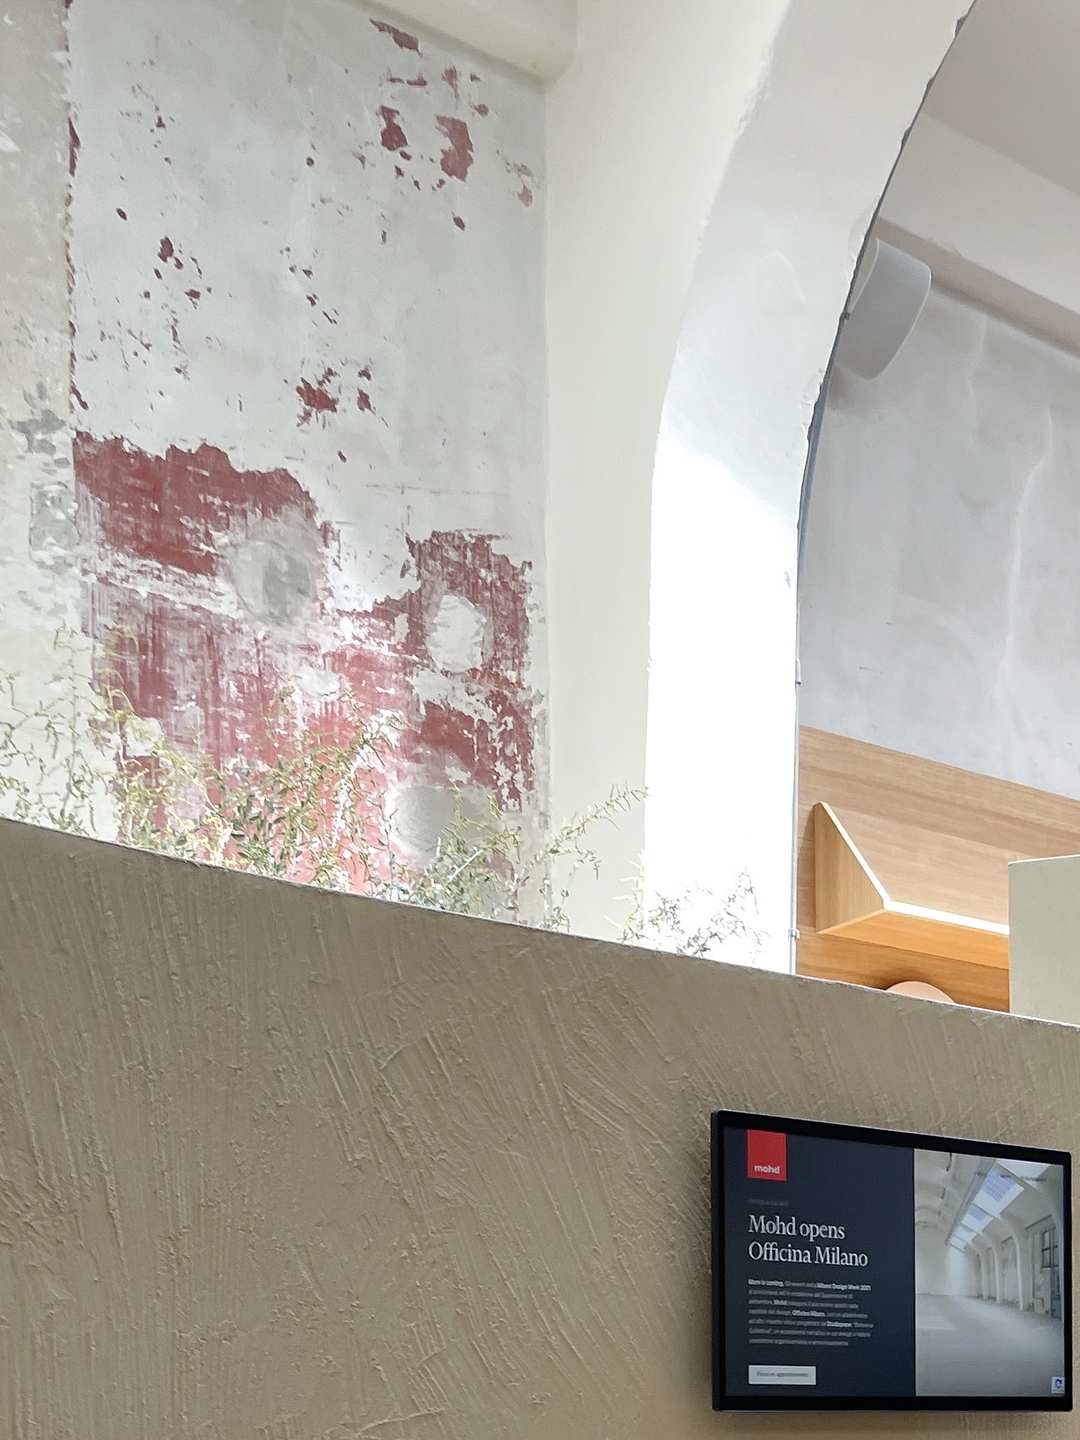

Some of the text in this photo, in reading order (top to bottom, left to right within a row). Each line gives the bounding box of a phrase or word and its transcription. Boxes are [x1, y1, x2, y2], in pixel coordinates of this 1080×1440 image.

[754, 1164, 781, 1175] mohd
[748, 1214, 846, 1242] Mohd opens
[748, 1241, 869, 1267] Officina Milano
